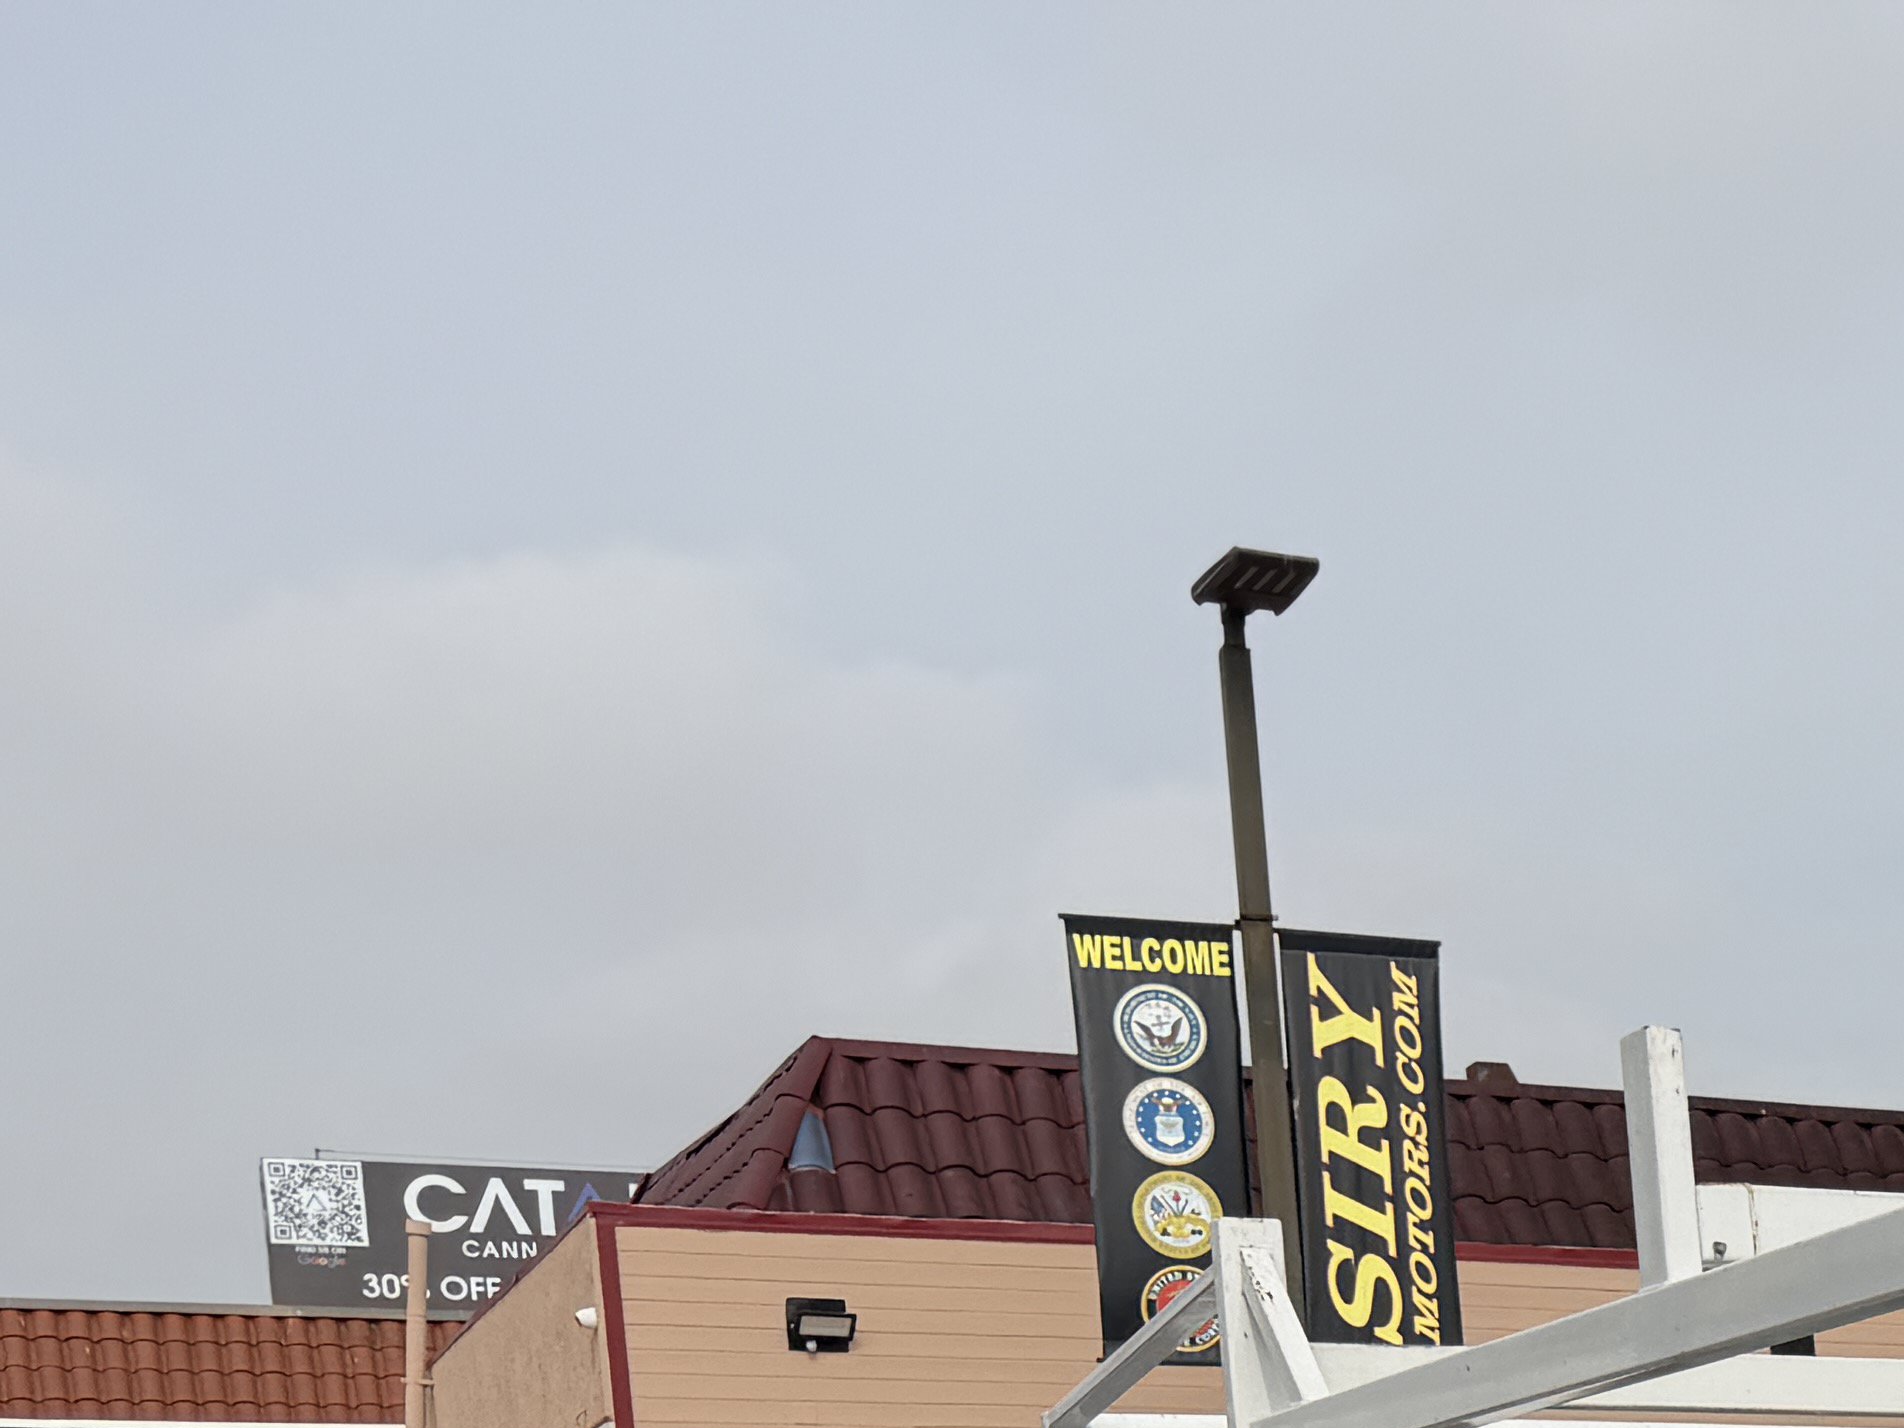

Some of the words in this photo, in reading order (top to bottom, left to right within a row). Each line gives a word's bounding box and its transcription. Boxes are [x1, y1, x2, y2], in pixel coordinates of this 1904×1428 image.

[1072, 933, 1232, 976] WELCOME
[1306, 951, 1403, 1345] SIRY
[1390, 961, 1441, 1346] MOTORS.COM
[440, 1275, 502, 1301] OFF
